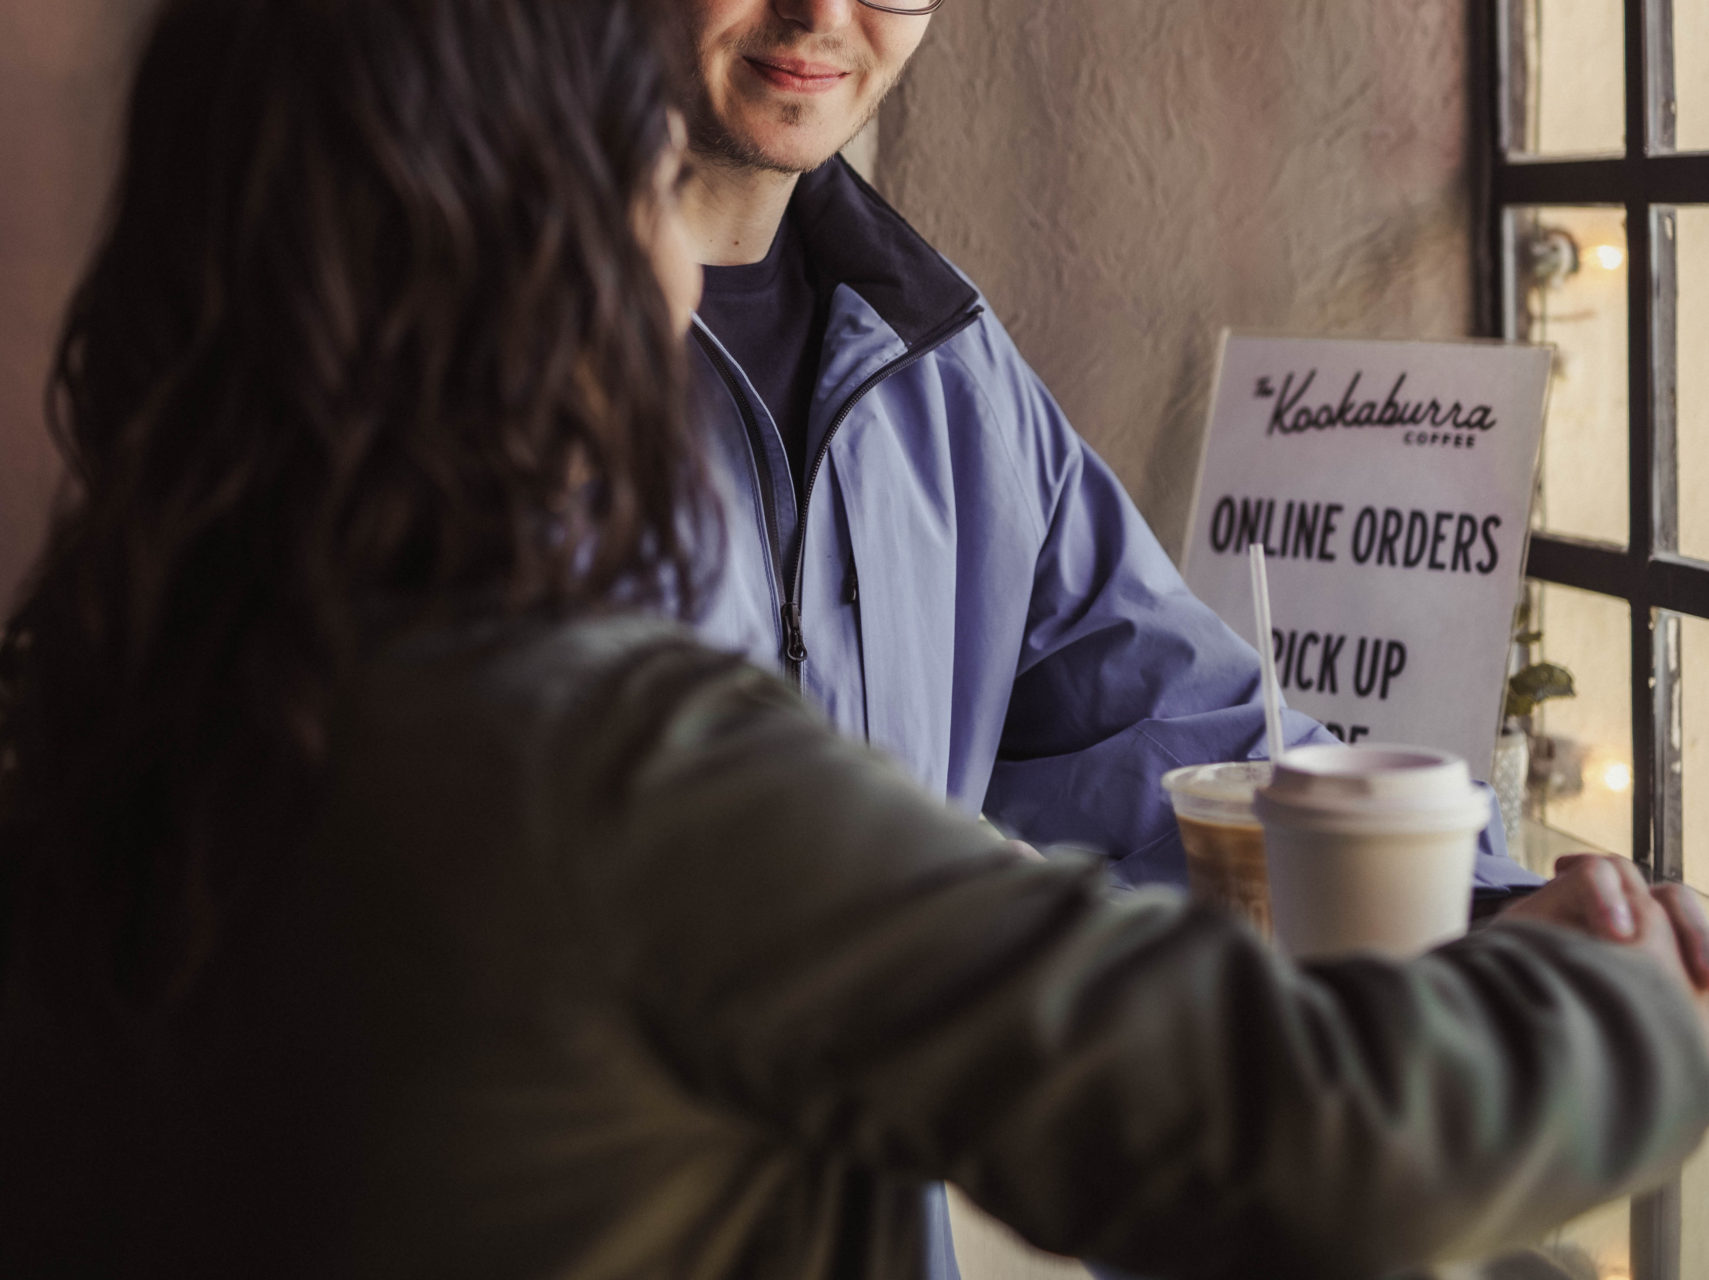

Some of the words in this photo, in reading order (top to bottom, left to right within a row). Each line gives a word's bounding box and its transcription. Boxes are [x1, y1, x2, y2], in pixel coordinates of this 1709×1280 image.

[1268, 370, 1497, 436] Kookaburra
[1404, 431, 1476, 448] COFFEE
[1210, 495, 1344, 562] ONLINE
[1352, 505, 1502, 575] ORDERS
[1354, 636, 1408, 700] UP
